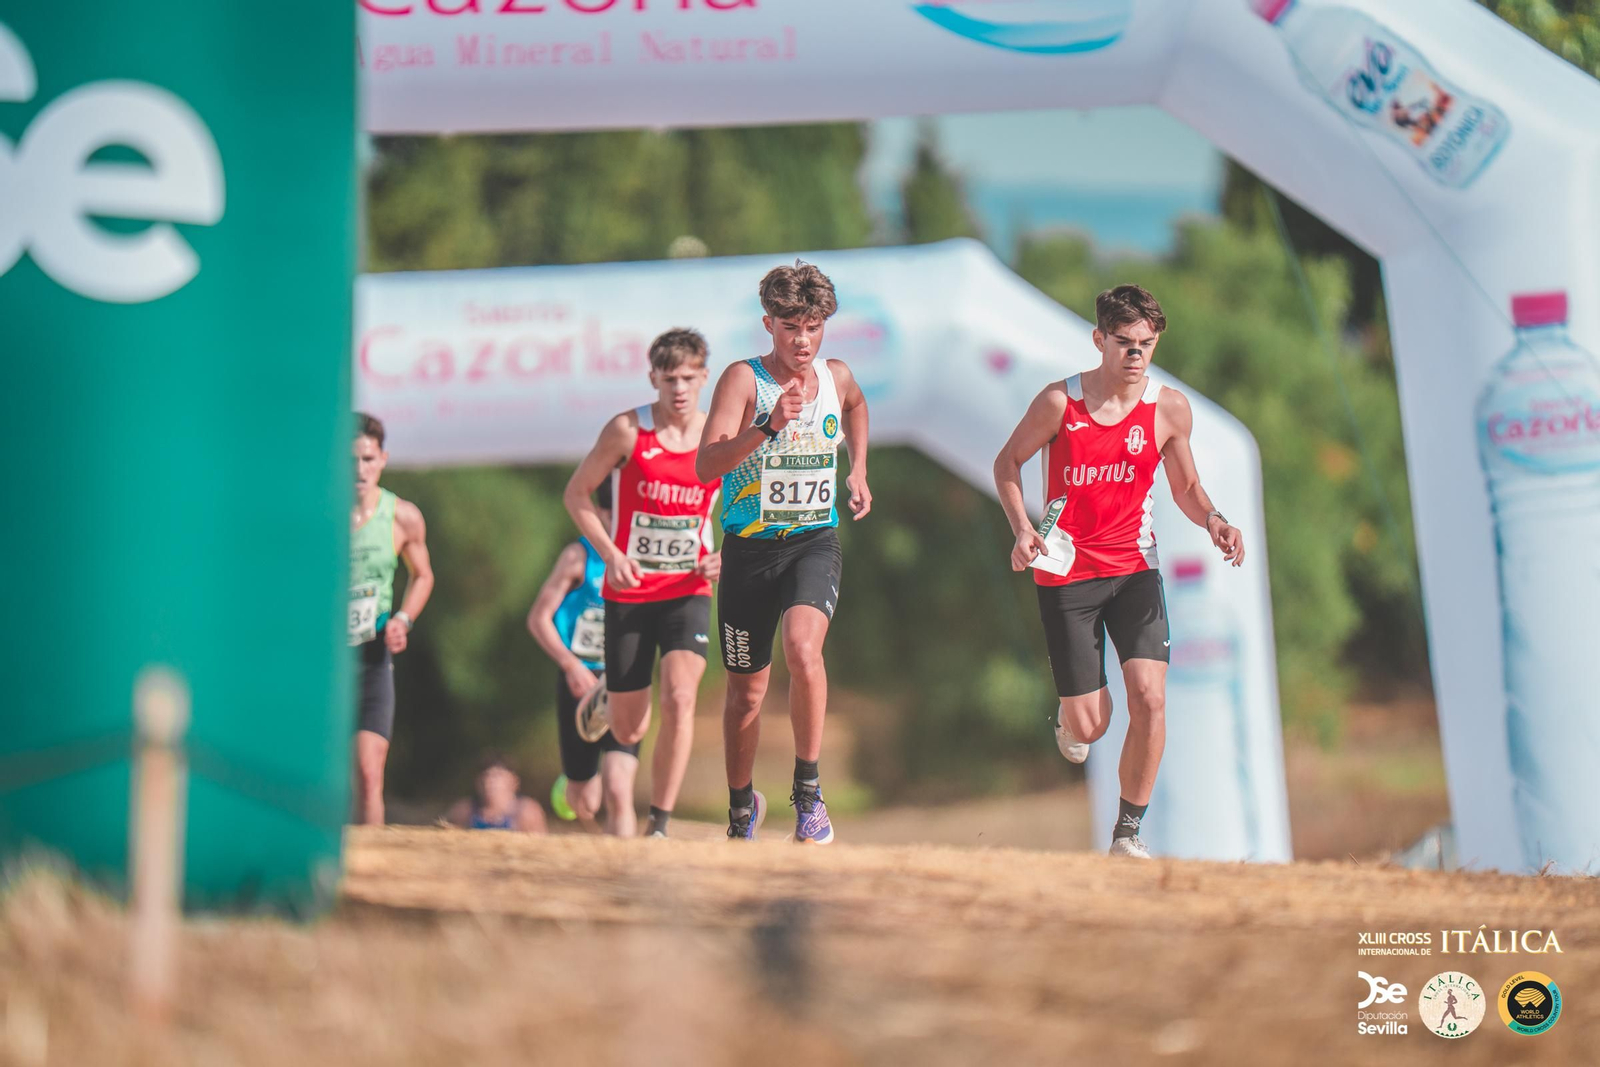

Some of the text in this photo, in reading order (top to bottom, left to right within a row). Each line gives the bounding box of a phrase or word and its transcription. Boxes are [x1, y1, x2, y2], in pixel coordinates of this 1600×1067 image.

[456, 33, 613, 67] Mineral
[638, 27, 797, 63] Natural
[1064, 461, 1136, 486] CURTIUS
[769, 480, 831, 504] 8176
[636, 537, 694, 556] 8162
[735, 628, 751, 668] SURCO
